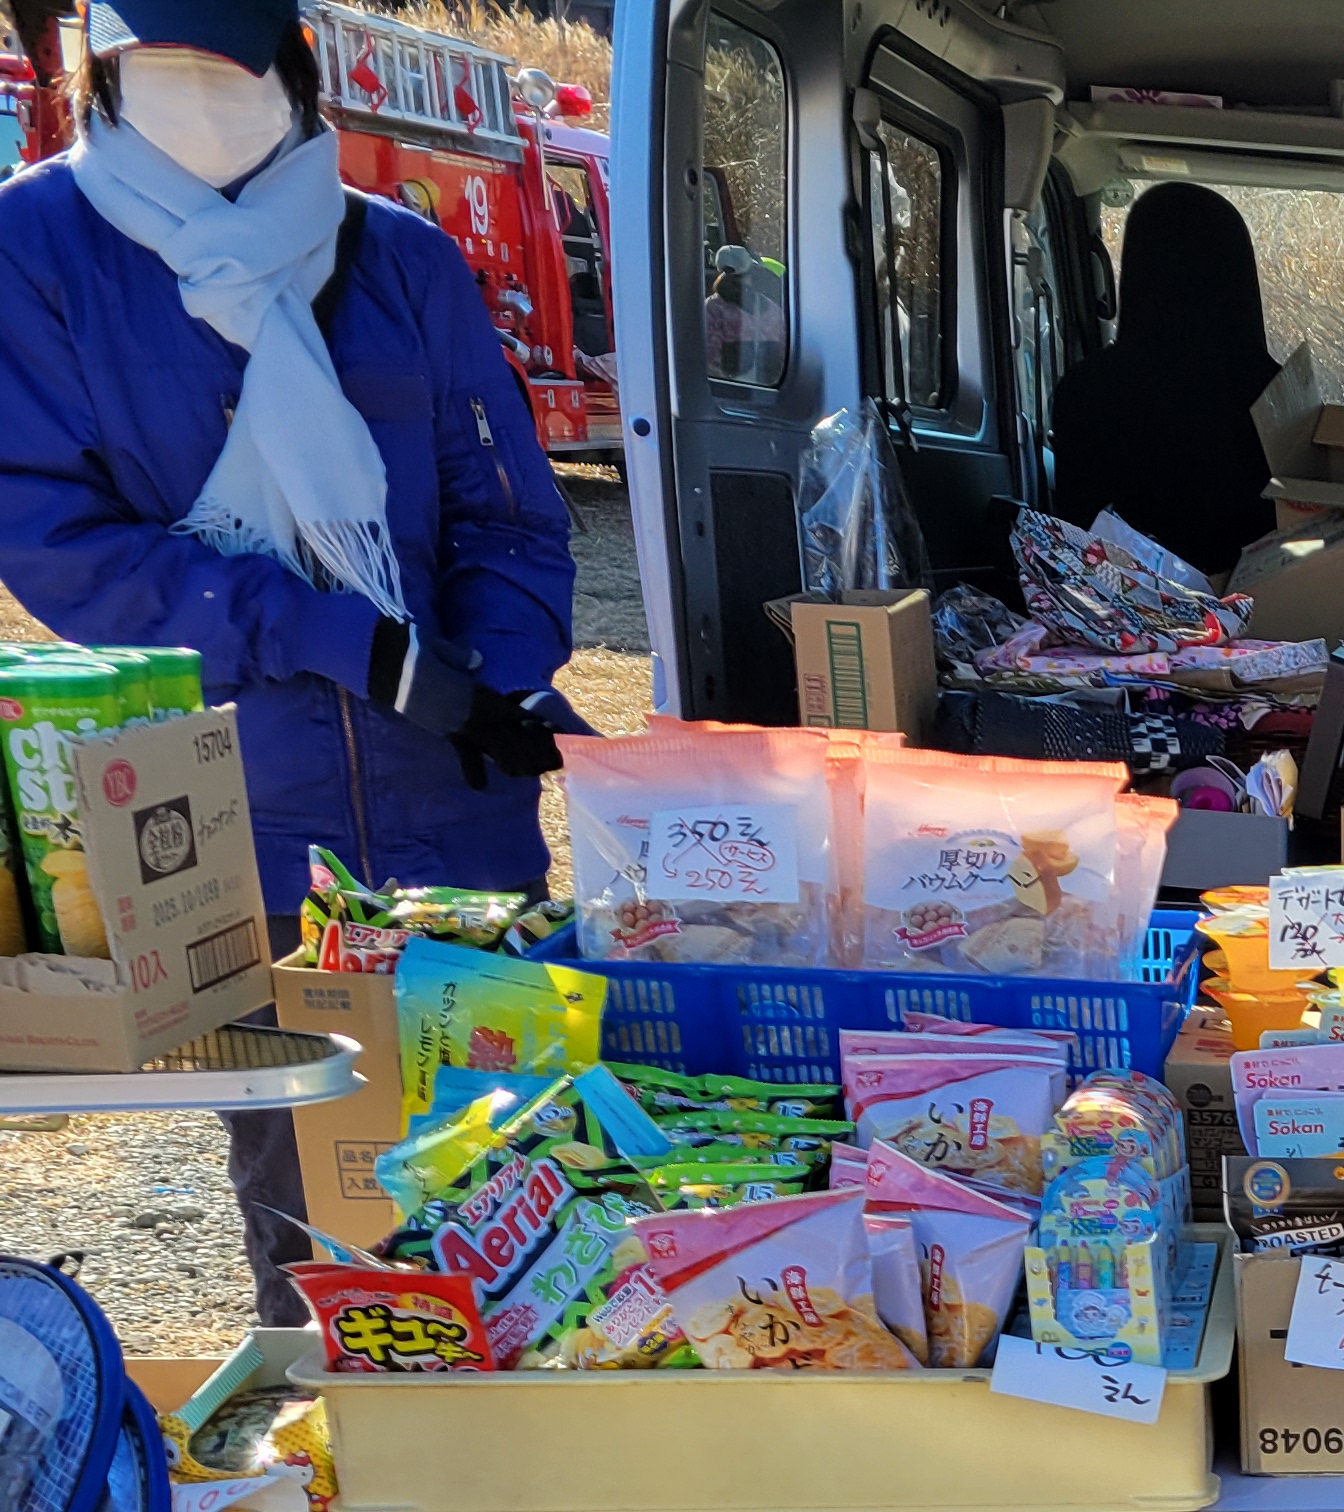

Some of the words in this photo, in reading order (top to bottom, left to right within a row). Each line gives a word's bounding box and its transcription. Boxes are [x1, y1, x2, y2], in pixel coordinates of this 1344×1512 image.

[465, 174, 489, 236] 19
[937, 848, 1007, 871] 厚切り
[901, 870, 1043, 893] バウムクーヘン
[129, 950, 168, 994] 10入
[439, 1161, 564, 1286] Aerial
[1257, 1227, 1342, 1251] ROASTED
